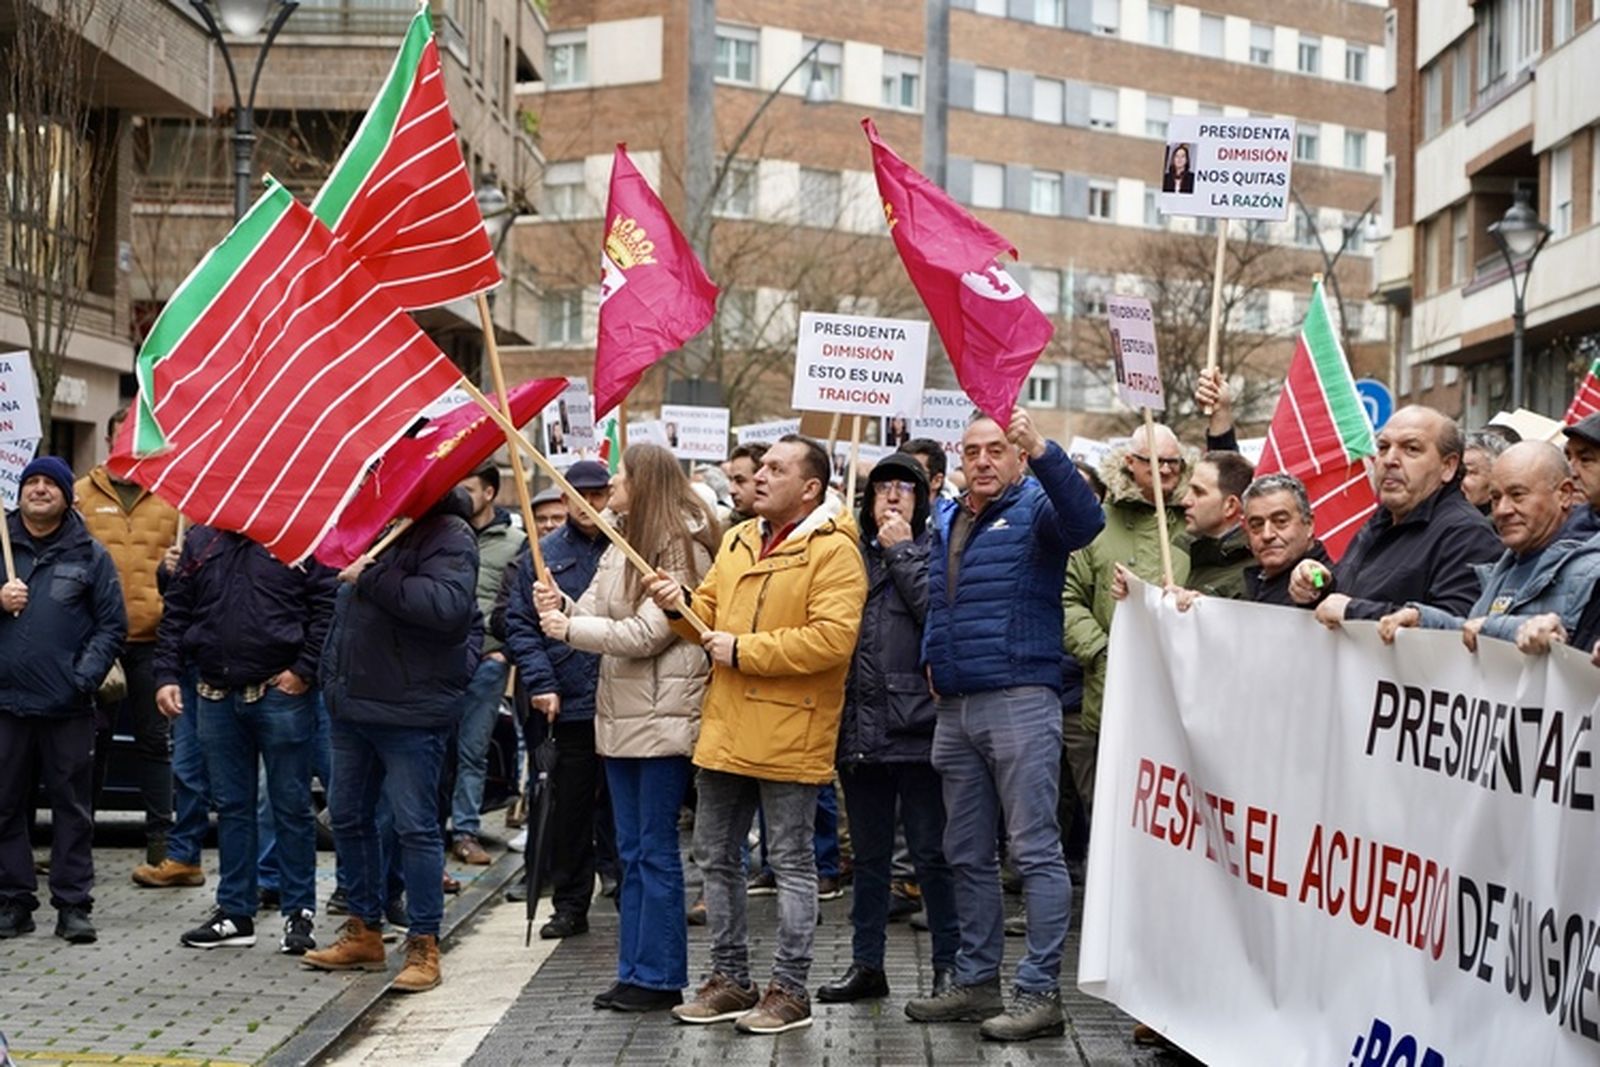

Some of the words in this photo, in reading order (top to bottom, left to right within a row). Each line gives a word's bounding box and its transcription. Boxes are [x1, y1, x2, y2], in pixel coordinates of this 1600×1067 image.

[1199, 125, 1290, 140] PRESIDENTA
[1218, 146, 1288, 162] DIMISIÓN
[1197, 170, 1230, 183] NOS
[1232, 171, 1286, 186] QUITAS
[1211, 194, 1229, 206] LA
[1232, 192, 1283, 208] RAZÓN
[814, 321, 906, 340] PRESIDENTA
[822, 343, 895, 361] DIMISIÓN
[808, 364, 846, 380] ESTO
[849, 368, 868, 382] ES
[872, 370, 904, 384] UNA
[819, 387, 891, 404] TRAICIÓN
[915, 418, 944, 428] ESTO
[946, 419, 961, 429] ES
[1366, 680, 1563, 804] PRESIDENTA
[1245, 806, 1288, 898] EL
[1298, 824, 1450, 961] ACUERDO
[1458, 875, 1507, 984] DE
[1505, 892, 1533, 1003] SU
